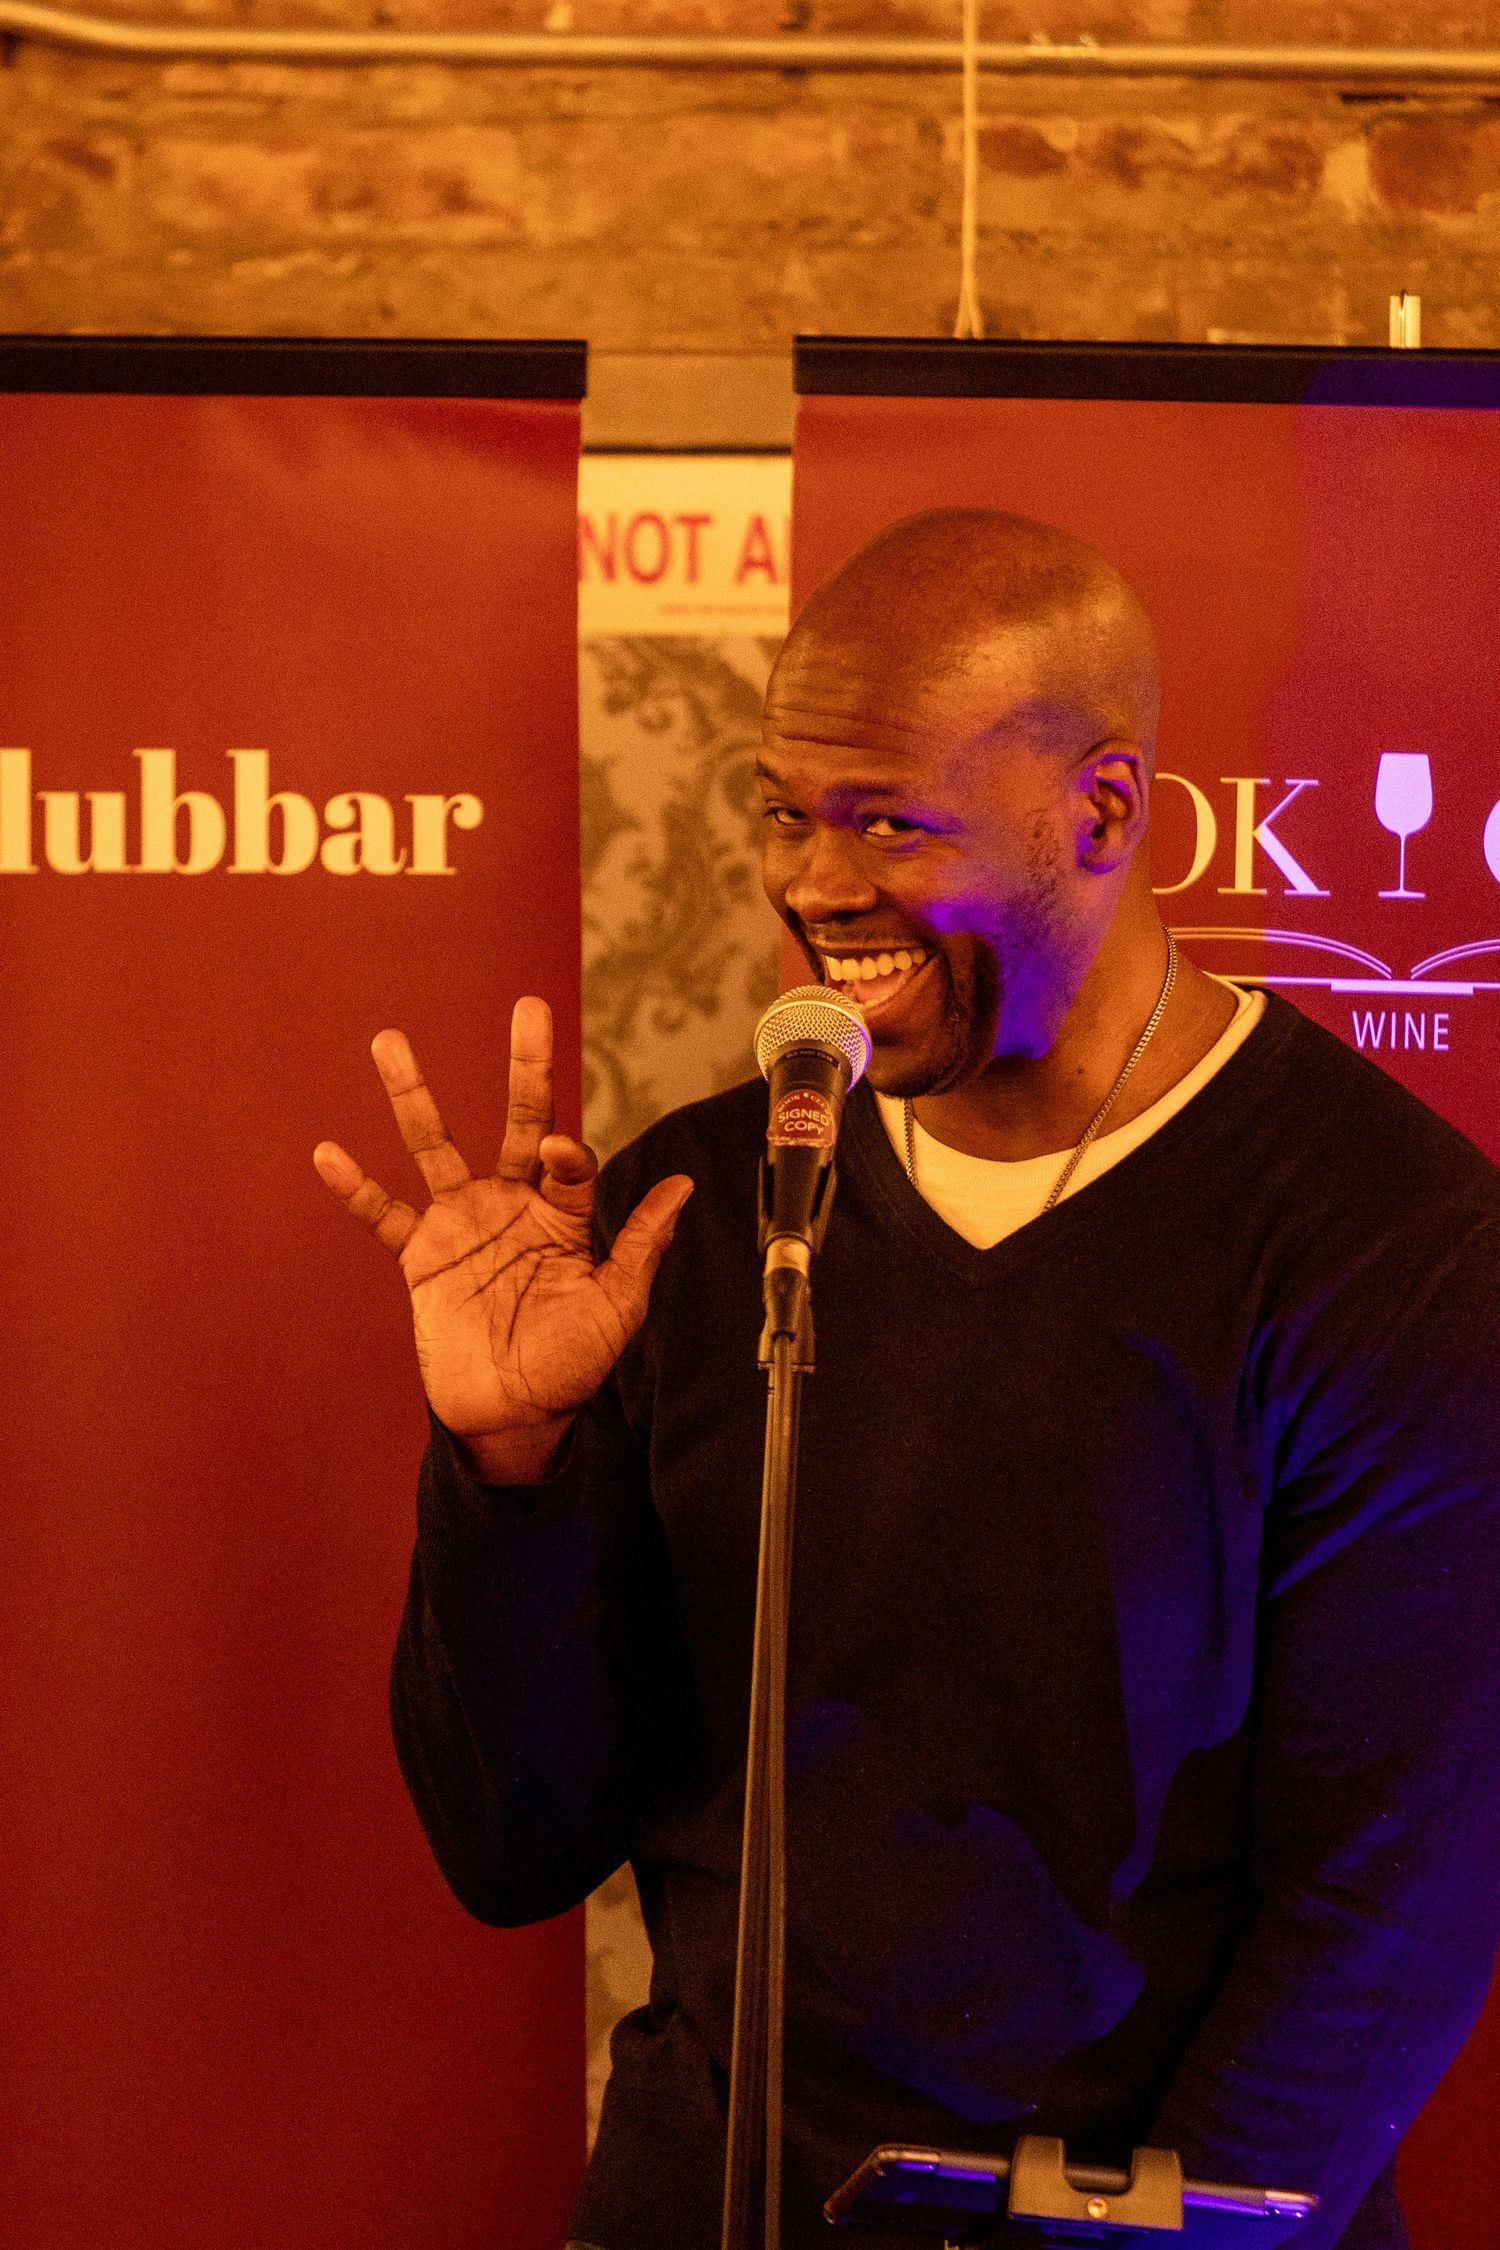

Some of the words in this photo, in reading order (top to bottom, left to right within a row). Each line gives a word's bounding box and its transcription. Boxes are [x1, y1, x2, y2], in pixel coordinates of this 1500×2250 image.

[577, 512, 713, 585] NOT
[0, 747, 485, 876] lubbar
[1352, 1010, 1450, 1051] WINE
[778, 1108, 830, 1127] SIGNED
[784, 1120, 824, 1135] COPY
